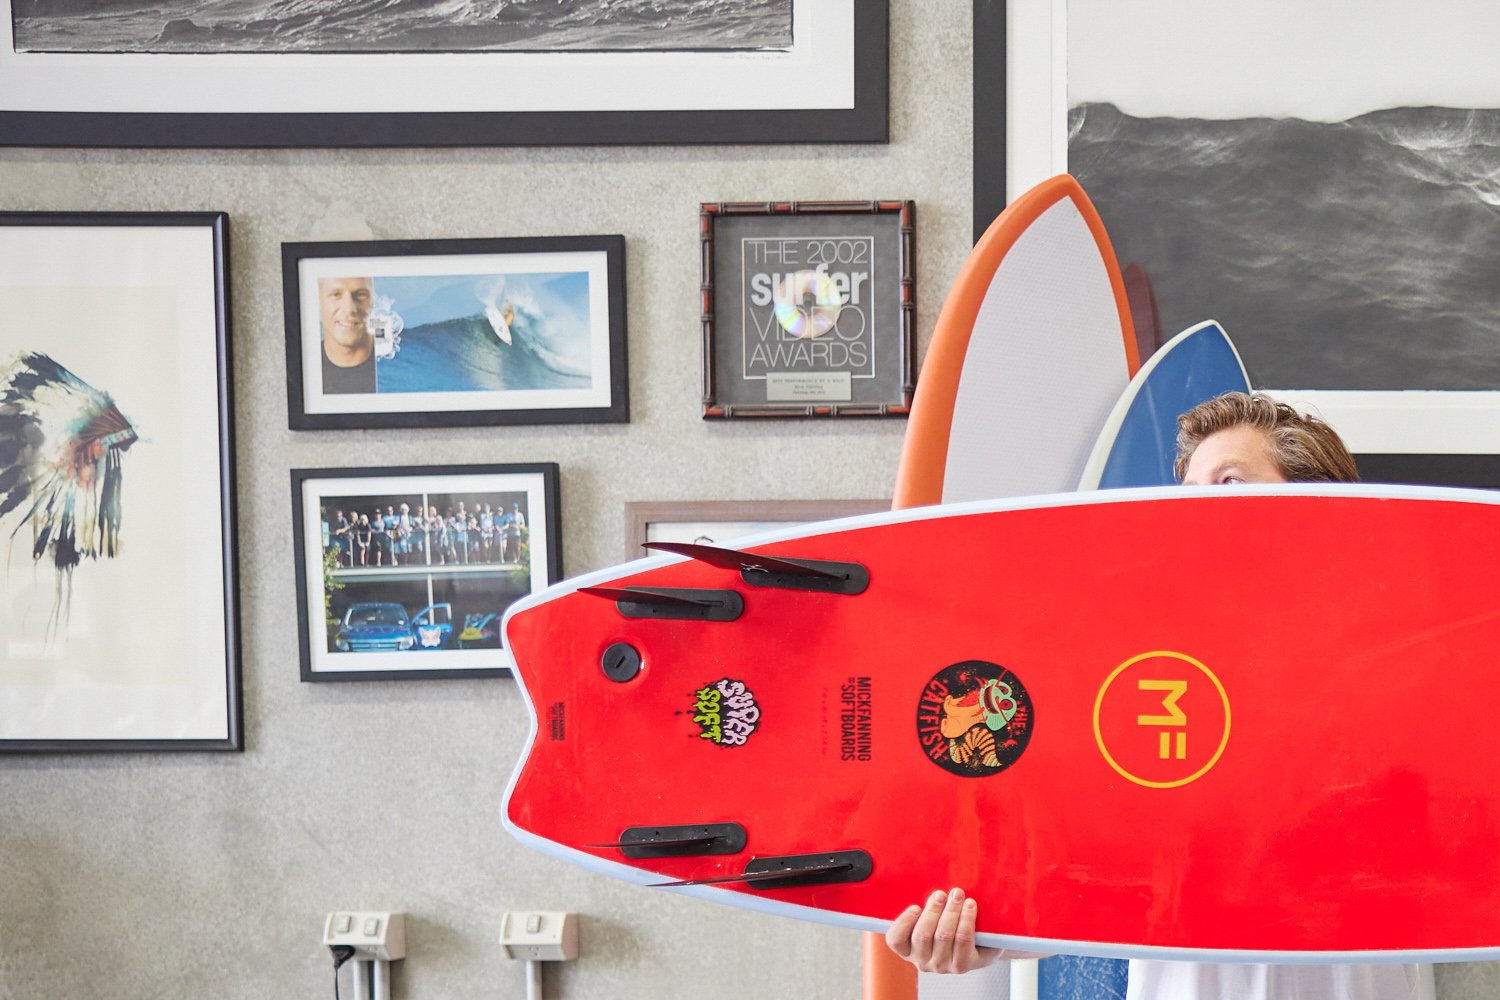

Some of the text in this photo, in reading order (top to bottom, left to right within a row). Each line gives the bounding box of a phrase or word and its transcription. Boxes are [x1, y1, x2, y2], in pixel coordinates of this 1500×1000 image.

[748, 240, 868, 264] THE 2002
[751, 263, 868, 306] surfer
[750, 304, 866, 341] VIDEO
[749, 342, 867, 368] AWARDS
[857, 677, 872, 762] MICKFANNING
[920, 680, 950, 760] CATFISH
